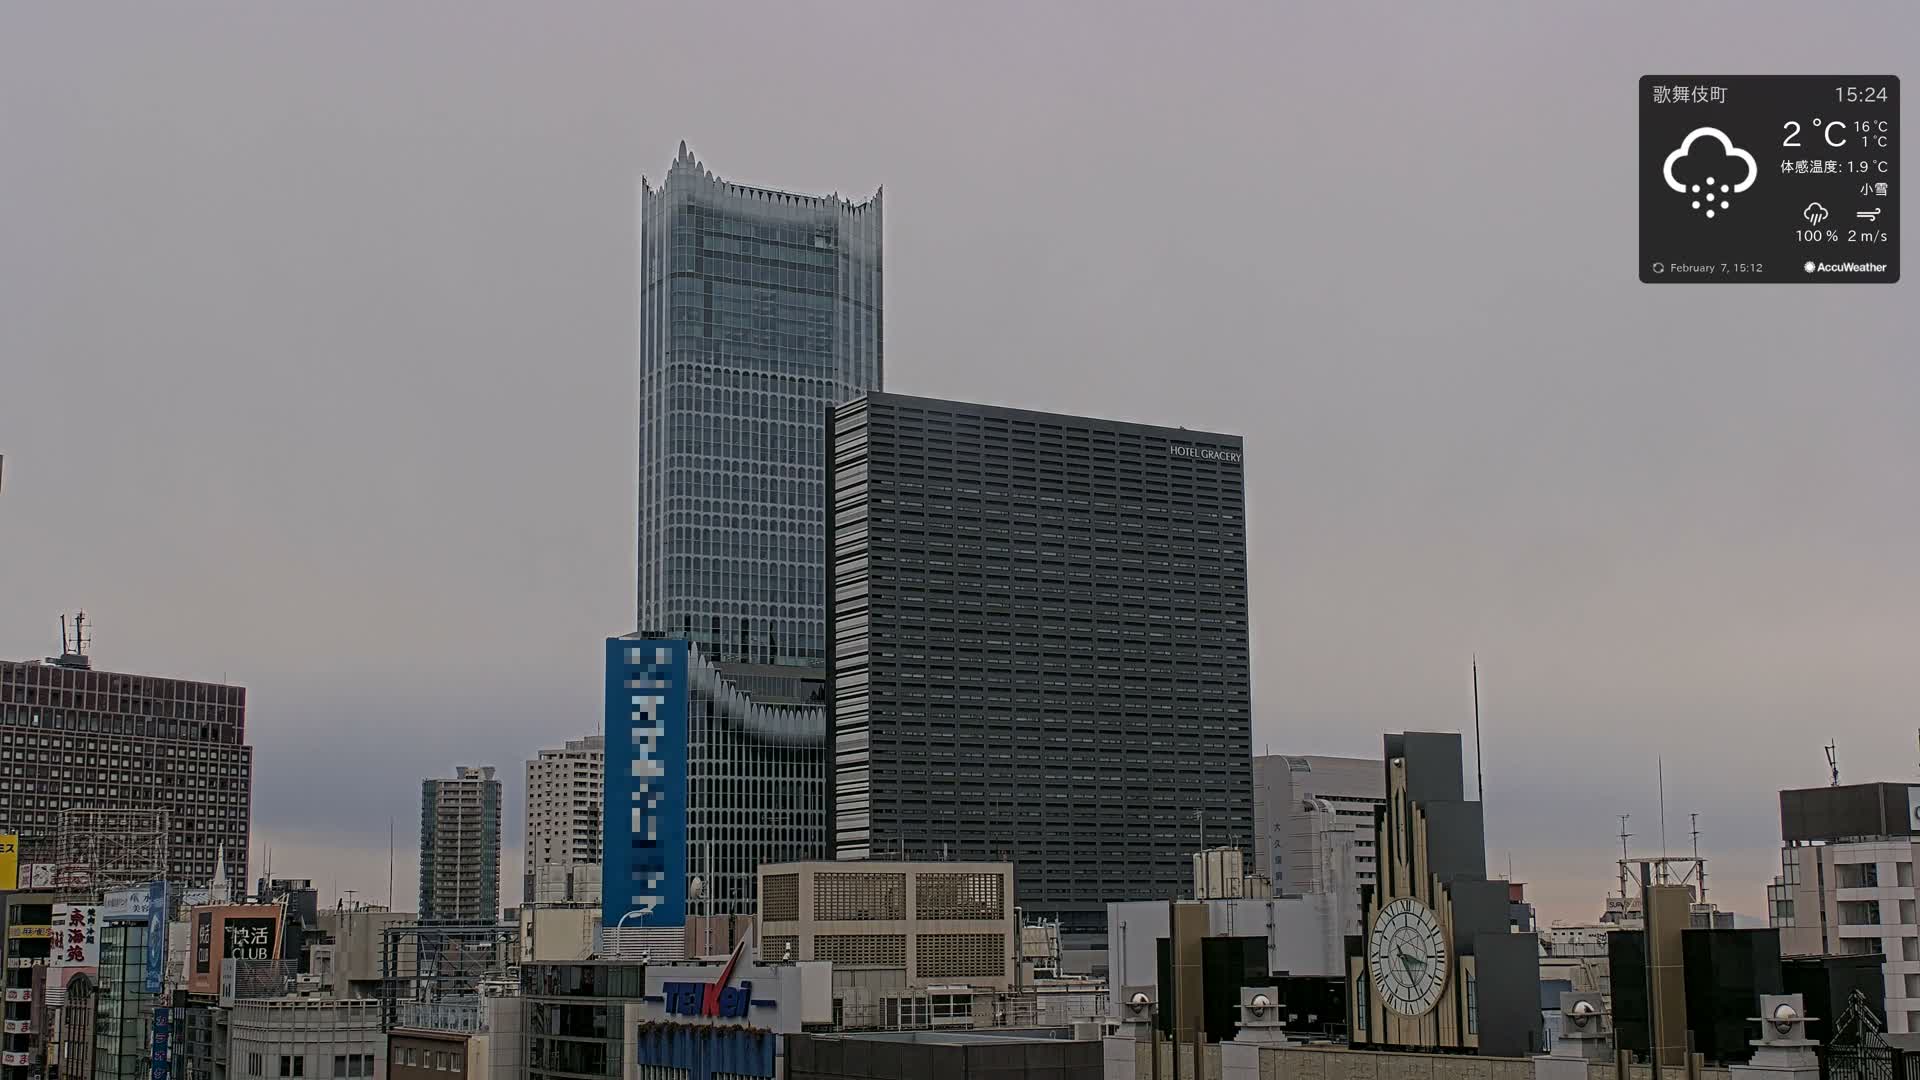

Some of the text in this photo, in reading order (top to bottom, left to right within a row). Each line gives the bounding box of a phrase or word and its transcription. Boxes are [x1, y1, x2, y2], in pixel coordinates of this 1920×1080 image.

[1170, 445, 1242, 462] HOTEL GRACERY
[234, 926, 269, 945] 快活
[232, 947, 268, 960] CLUB
